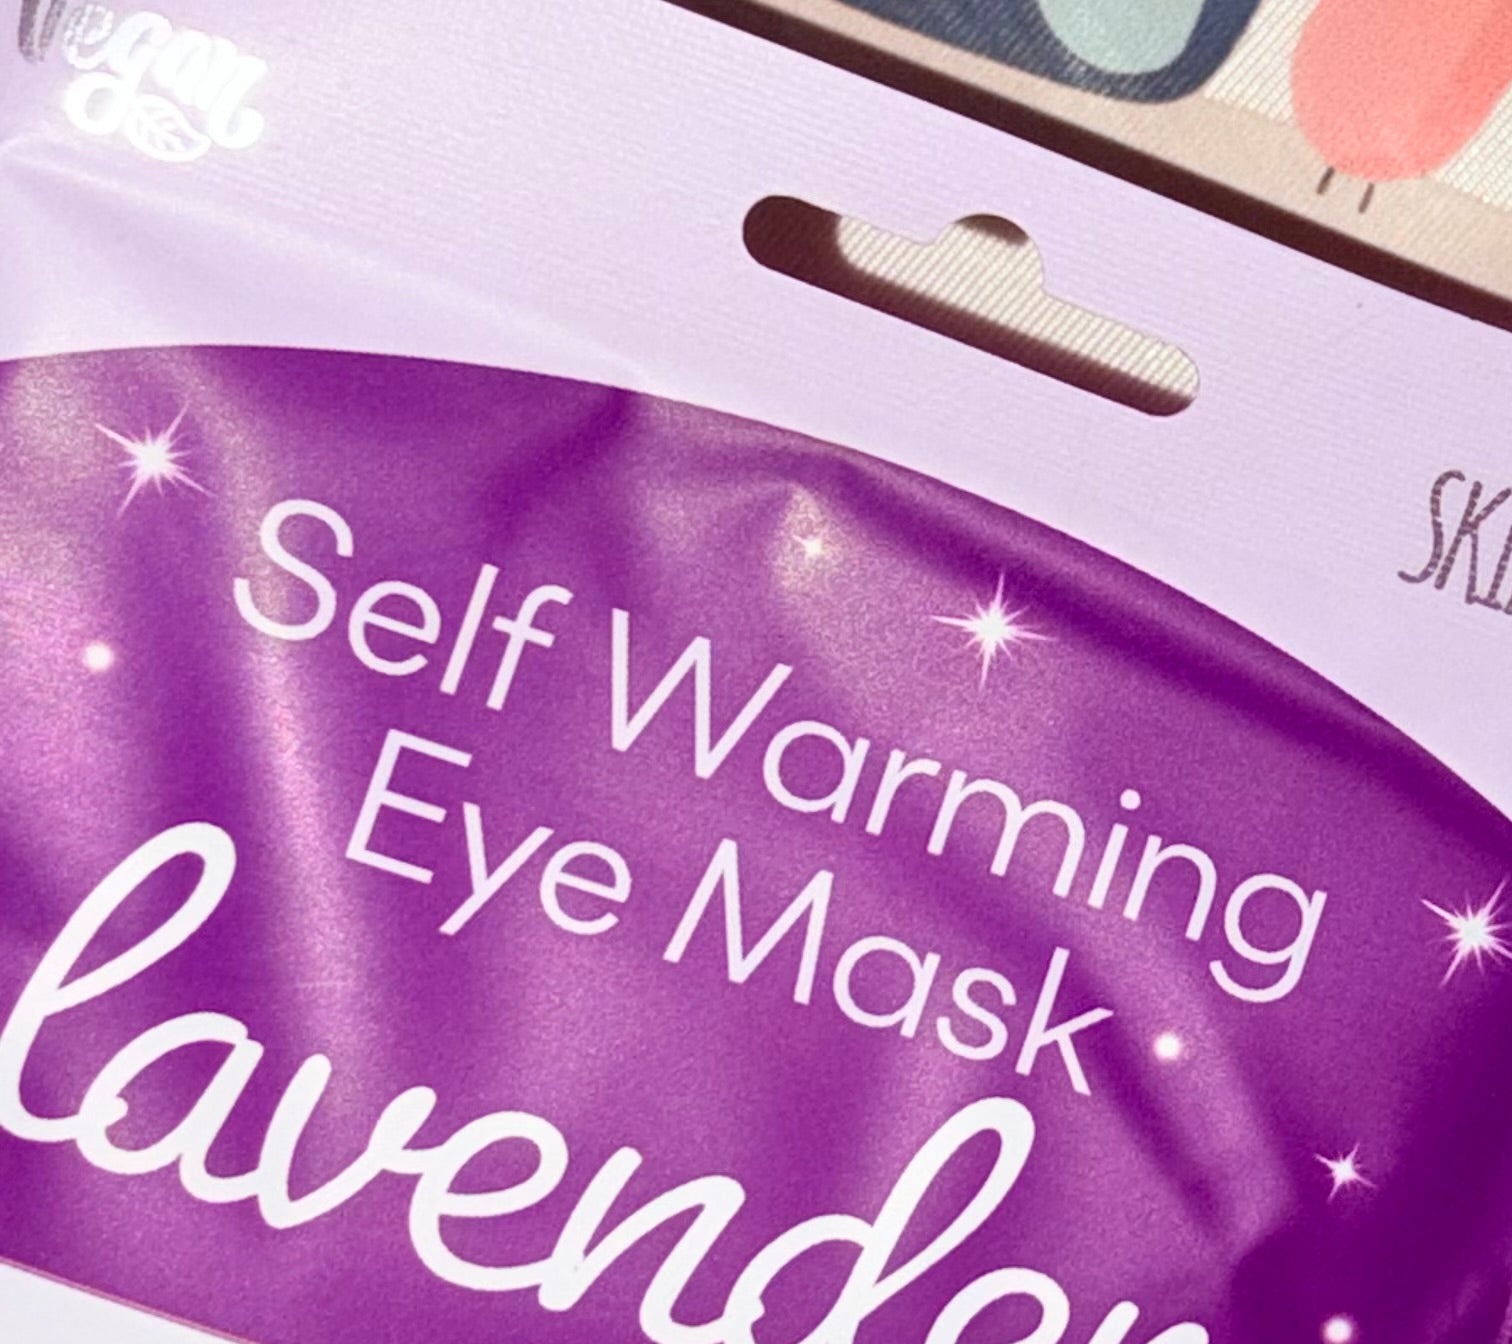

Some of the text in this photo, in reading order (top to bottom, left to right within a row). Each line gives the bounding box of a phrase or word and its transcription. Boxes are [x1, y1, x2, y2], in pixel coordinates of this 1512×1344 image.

[233, 498, 1327, 1003] Self Warming
[344, 727, 1113, 1096] Eye Mask
